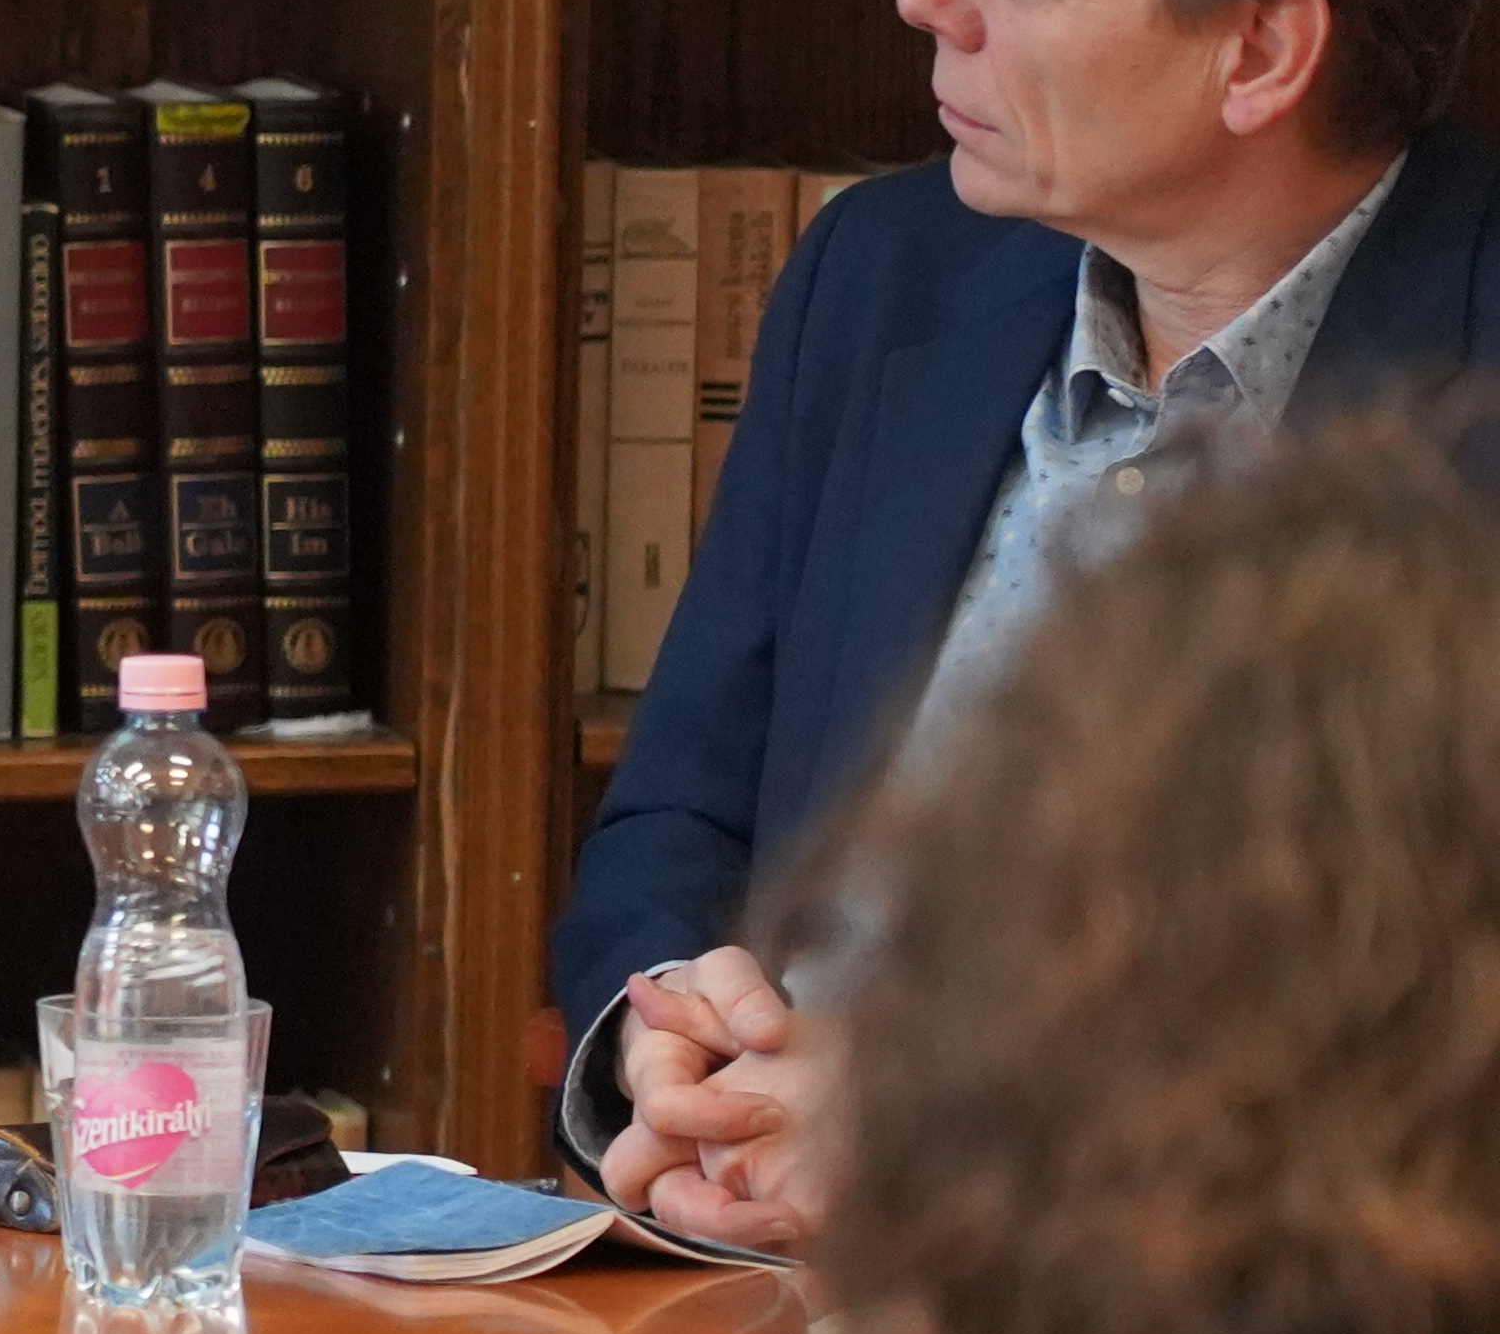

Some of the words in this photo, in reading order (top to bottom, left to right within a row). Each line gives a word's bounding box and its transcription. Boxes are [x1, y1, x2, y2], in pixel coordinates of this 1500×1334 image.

[96, 166, 113, 193] 1
[199, 163, 217, 191] 4
[72, 1096, 212, 1157] zentkirályi
